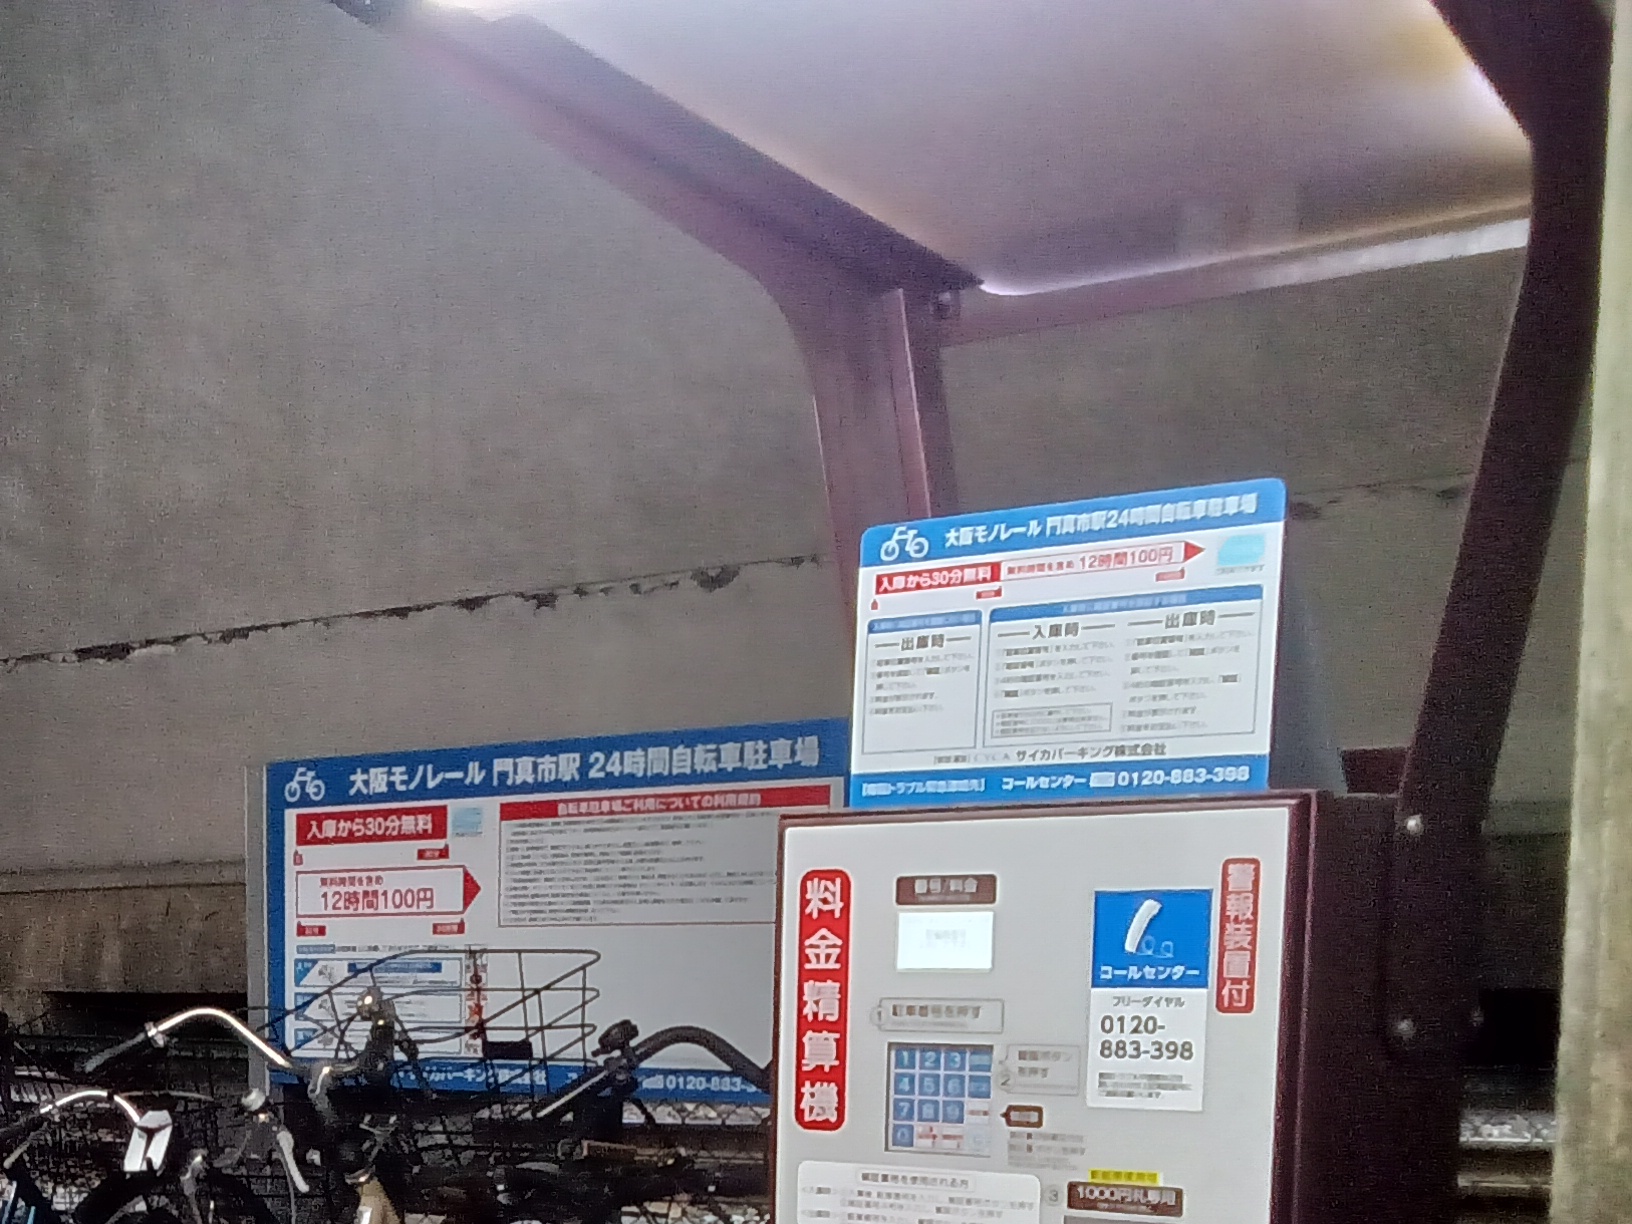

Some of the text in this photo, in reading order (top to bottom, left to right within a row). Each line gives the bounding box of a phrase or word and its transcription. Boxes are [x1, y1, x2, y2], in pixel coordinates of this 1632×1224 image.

[349, 764, 485, 797] 大阪モノレール
[320, 888, 435, 911] 12時間100円
[1099, 964, 1200, 981] コールセンター
[800, 877, 844, 1124] 料金精算機
[1100, 1014, 1165, 1035] 0120-
[1099, 1039, 1194, 1061] 883-398
